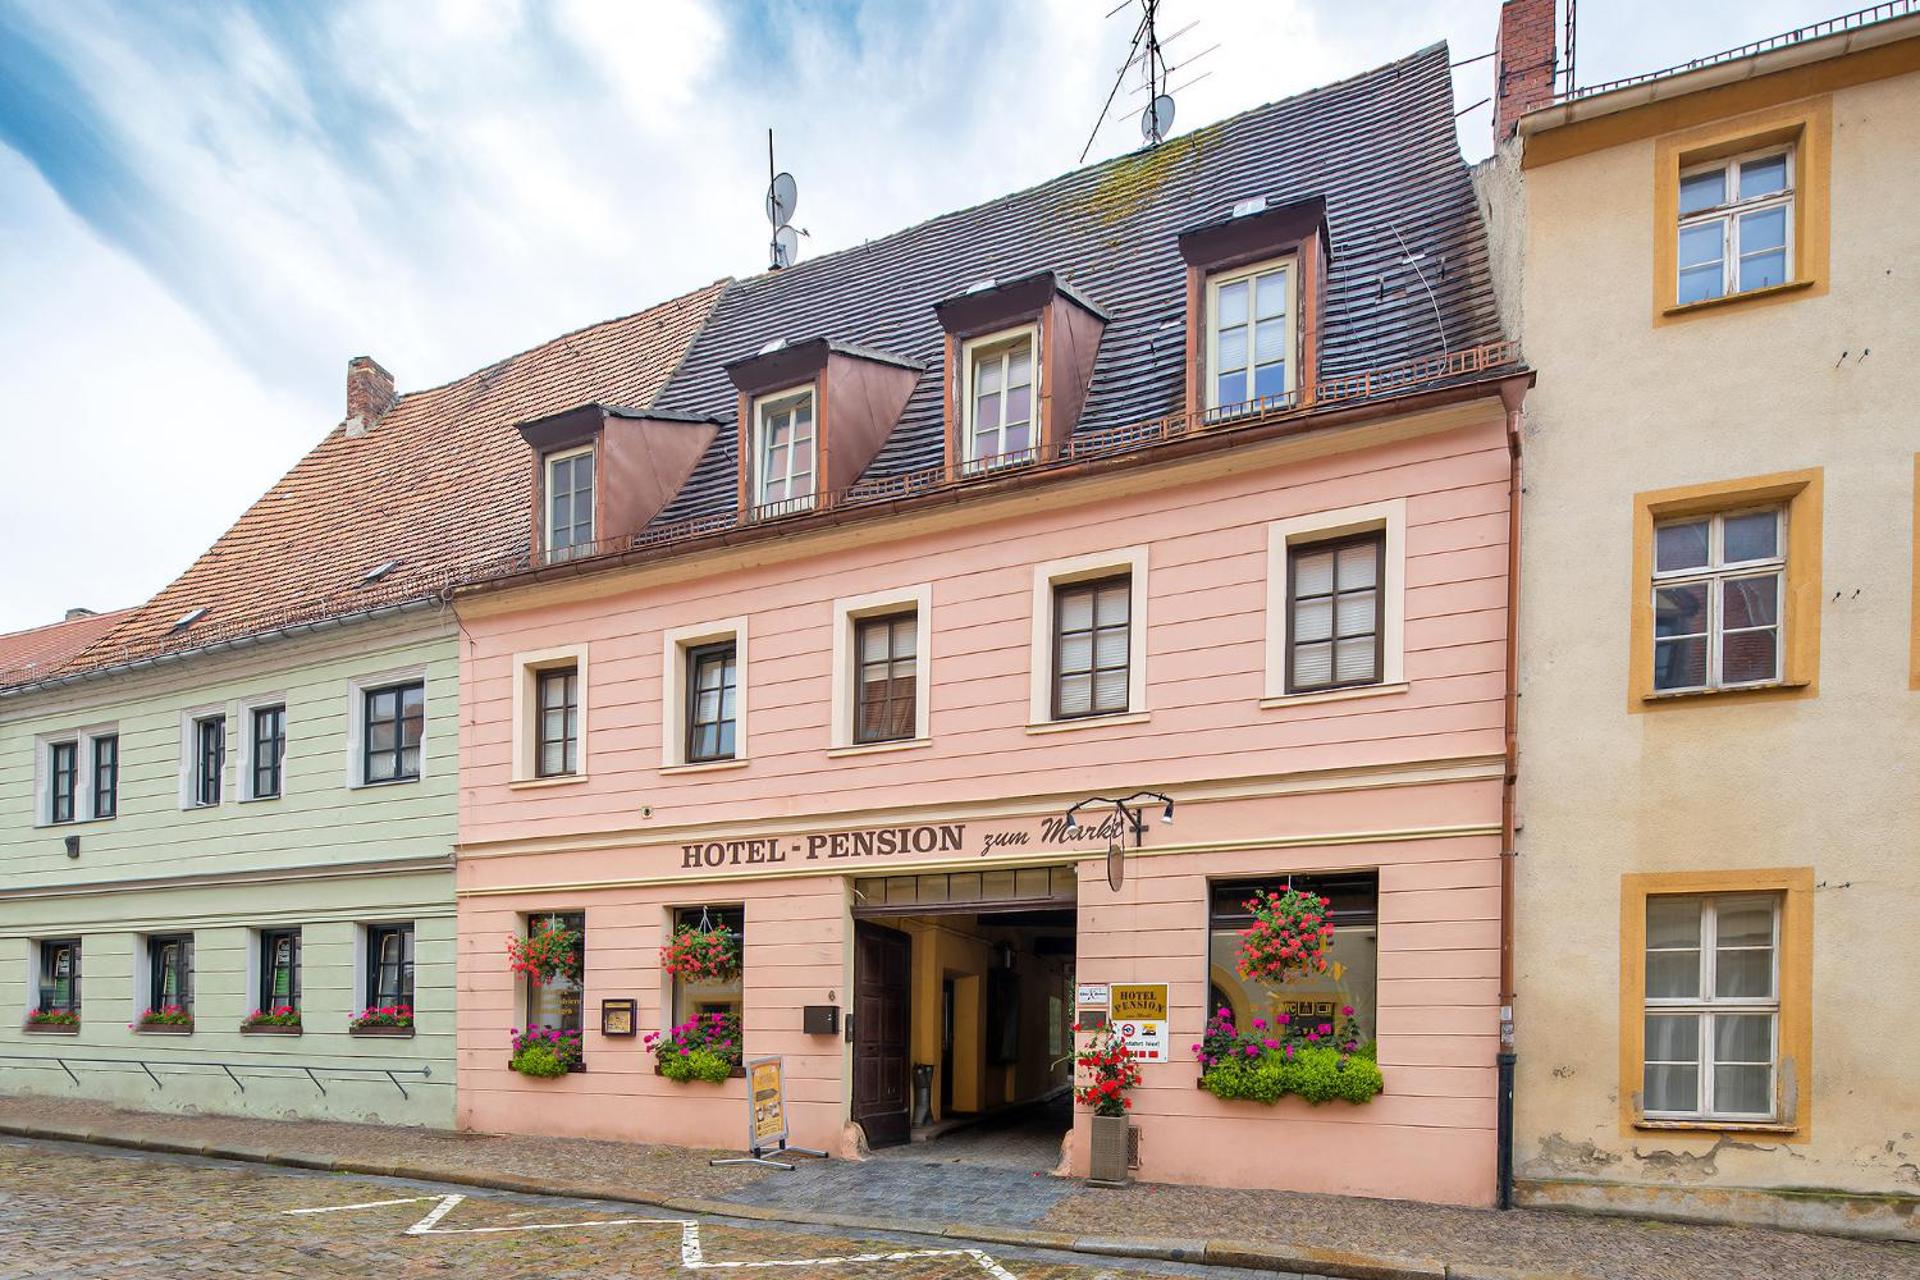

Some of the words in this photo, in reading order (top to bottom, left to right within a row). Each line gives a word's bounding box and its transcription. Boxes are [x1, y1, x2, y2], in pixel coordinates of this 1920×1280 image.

[981, 830, 1030, 857] zum
[1120, 991, 1156, 1000] HOTEL
[1114, 1000, 1165, 1013] PENSION
